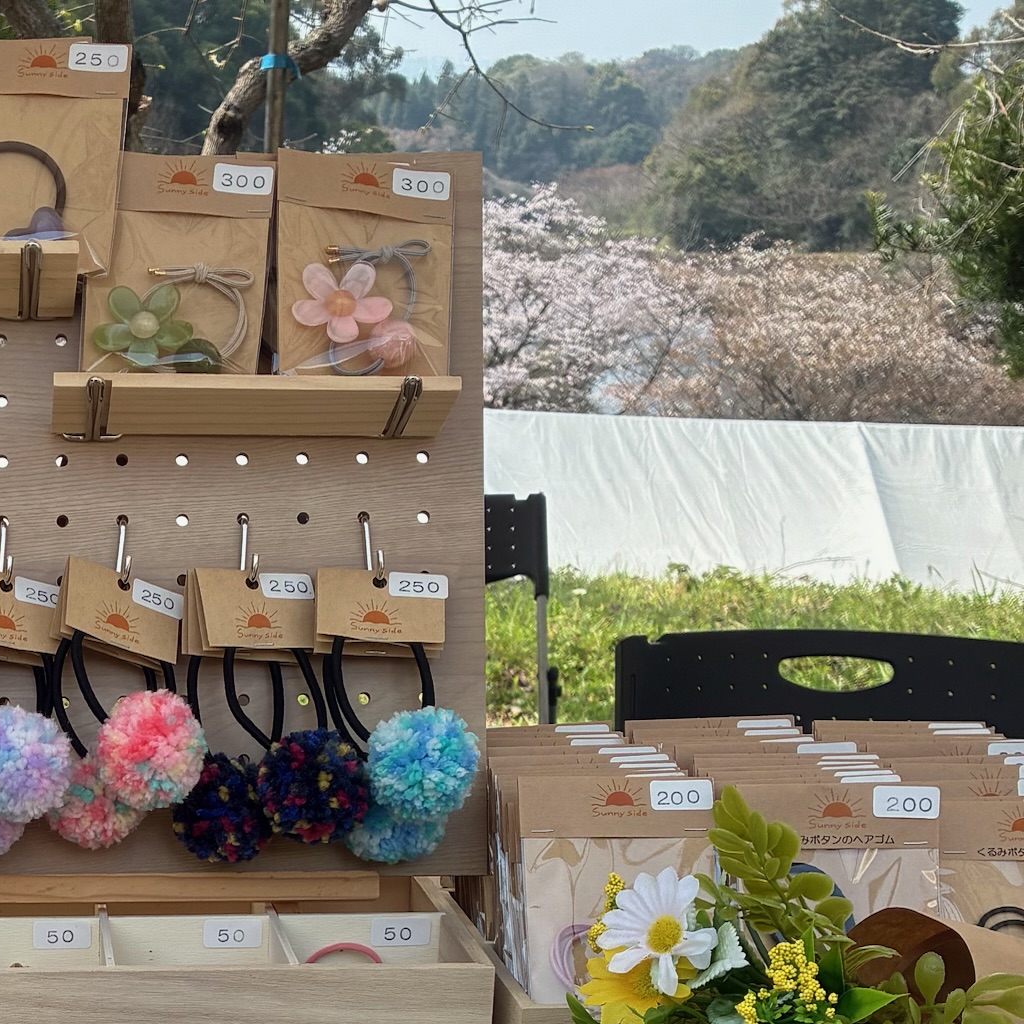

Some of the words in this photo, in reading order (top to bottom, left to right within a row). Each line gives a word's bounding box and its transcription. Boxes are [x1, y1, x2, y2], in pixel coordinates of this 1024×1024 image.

[75, 52, 120, 67] 250
[221, 173, 266, 189] 300
[401, 178, 445, 194] 300
[399, 580, 440, 593] 250
[141, 590, 175, 610] 250
[95, 621, 120, 639] Sunny
[121, 633, 140, 644] side
[237, 629, 264, 641] Sunny
[265, 630, 284, 640] side
[351, 621, 381, 635] Sunny
[382, 625, 402, 635] side
[9, 632, 28, 643] side
[657, 789, 701, 806] 200
[886, 797, 933, 813] 200
[592, 807, 625, 818] Sunny
[626, 808, 648, 818] side
[808, 818, 843, 830] Sunny
[844, 820, 868, 830] side
[801, 834, 895, 846] みボタンのヘアゴム
[46, 929, 74, 944] 50
[217, 929, 245, 943] 50
[383, 927, 412, 941] 50
